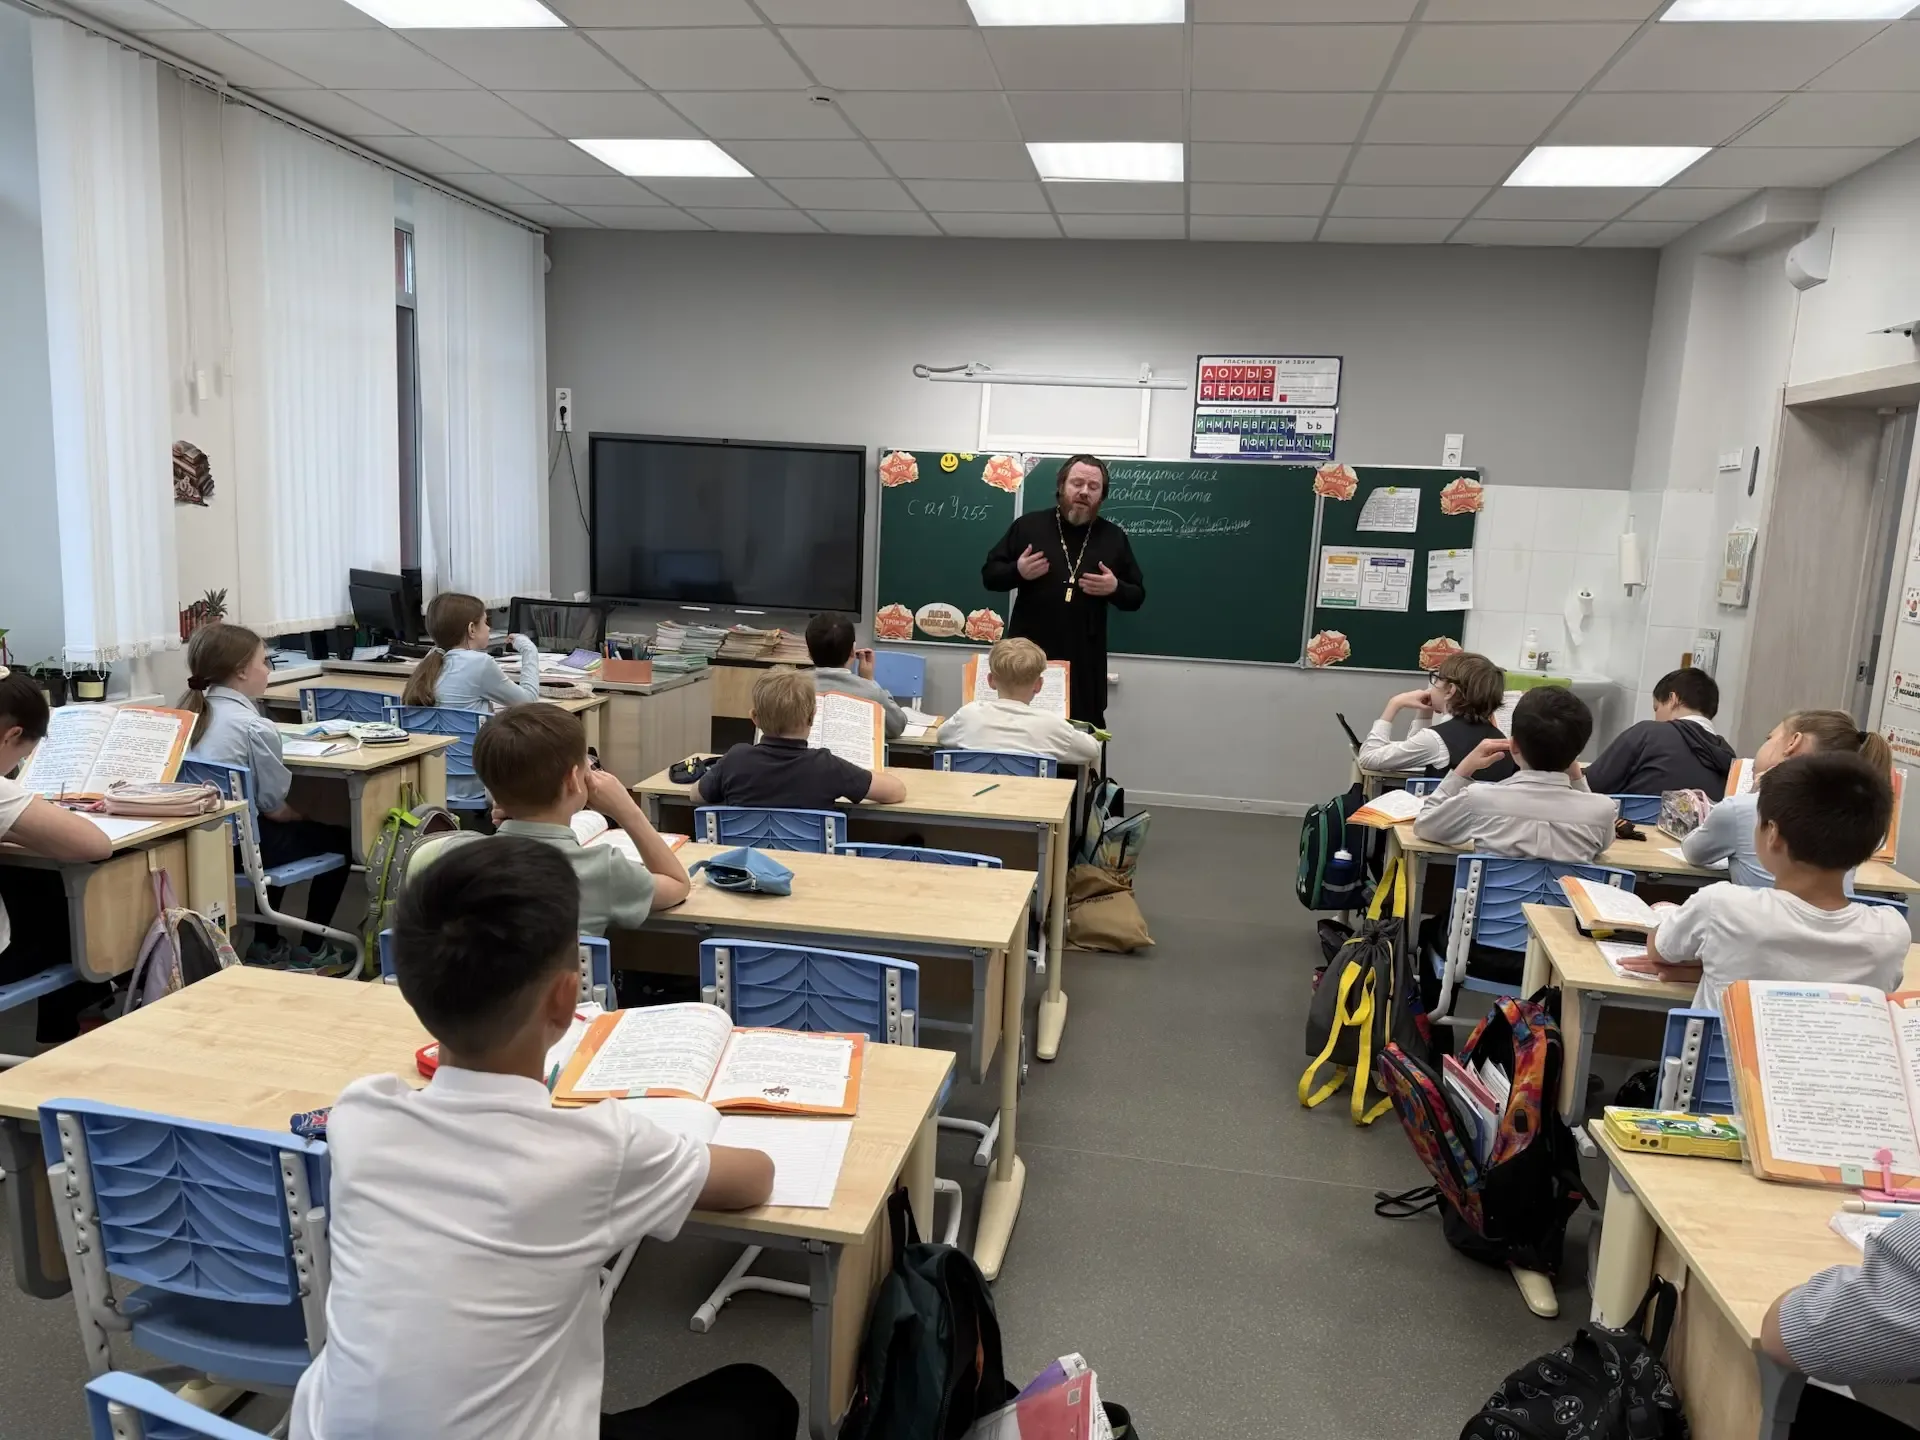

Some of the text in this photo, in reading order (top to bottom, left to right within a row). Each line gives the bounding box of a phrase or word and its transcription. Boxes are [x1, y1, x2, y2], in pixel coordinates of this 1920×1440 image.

[1203, 368, 1214, 378] А
[1218, 368, 1229, 378] О
[1233, 368, 1243, 378] У
[1247, 368, 1260, 378] Ы
[1263, 368, 1273, 378] Э
[1203, 386, 1213, 396] Я
[1218, 383, 1227, 396] Ё
[1230, 386, 1244, 396] Ю
[1247, 386, 1257, 396] И
[1262, 386, 1271, 396] Е
[1197, 418, 1296, 430] Й Н М Л Р Б В Г Д З Ж
[1241, 438, 1248, 446] П
[1249, 438, 1258, 446] Ф
[1269, 439, 1275, 447] Т
[1277, 439, 1284, 447] С
[1286, 439, 1295, 447] Ш
[1296, 439, 1302, 447] Х
[1304, 439, 1312, 448] Ц
[1322, 440, 1331, 449] Щ
[1107, 464, 1184, 489] енадцатое
[1152, 483, 1213, 511] работа
[924, 501, 945, 517] 121
[962, 504, 994, 521] 255
[928, 609, 952, 619] ДЕНЬ
[883, 618, 907, 626] ГЕРОИЗМ
[1316, 642, 1339, 654] ОТВАГА
